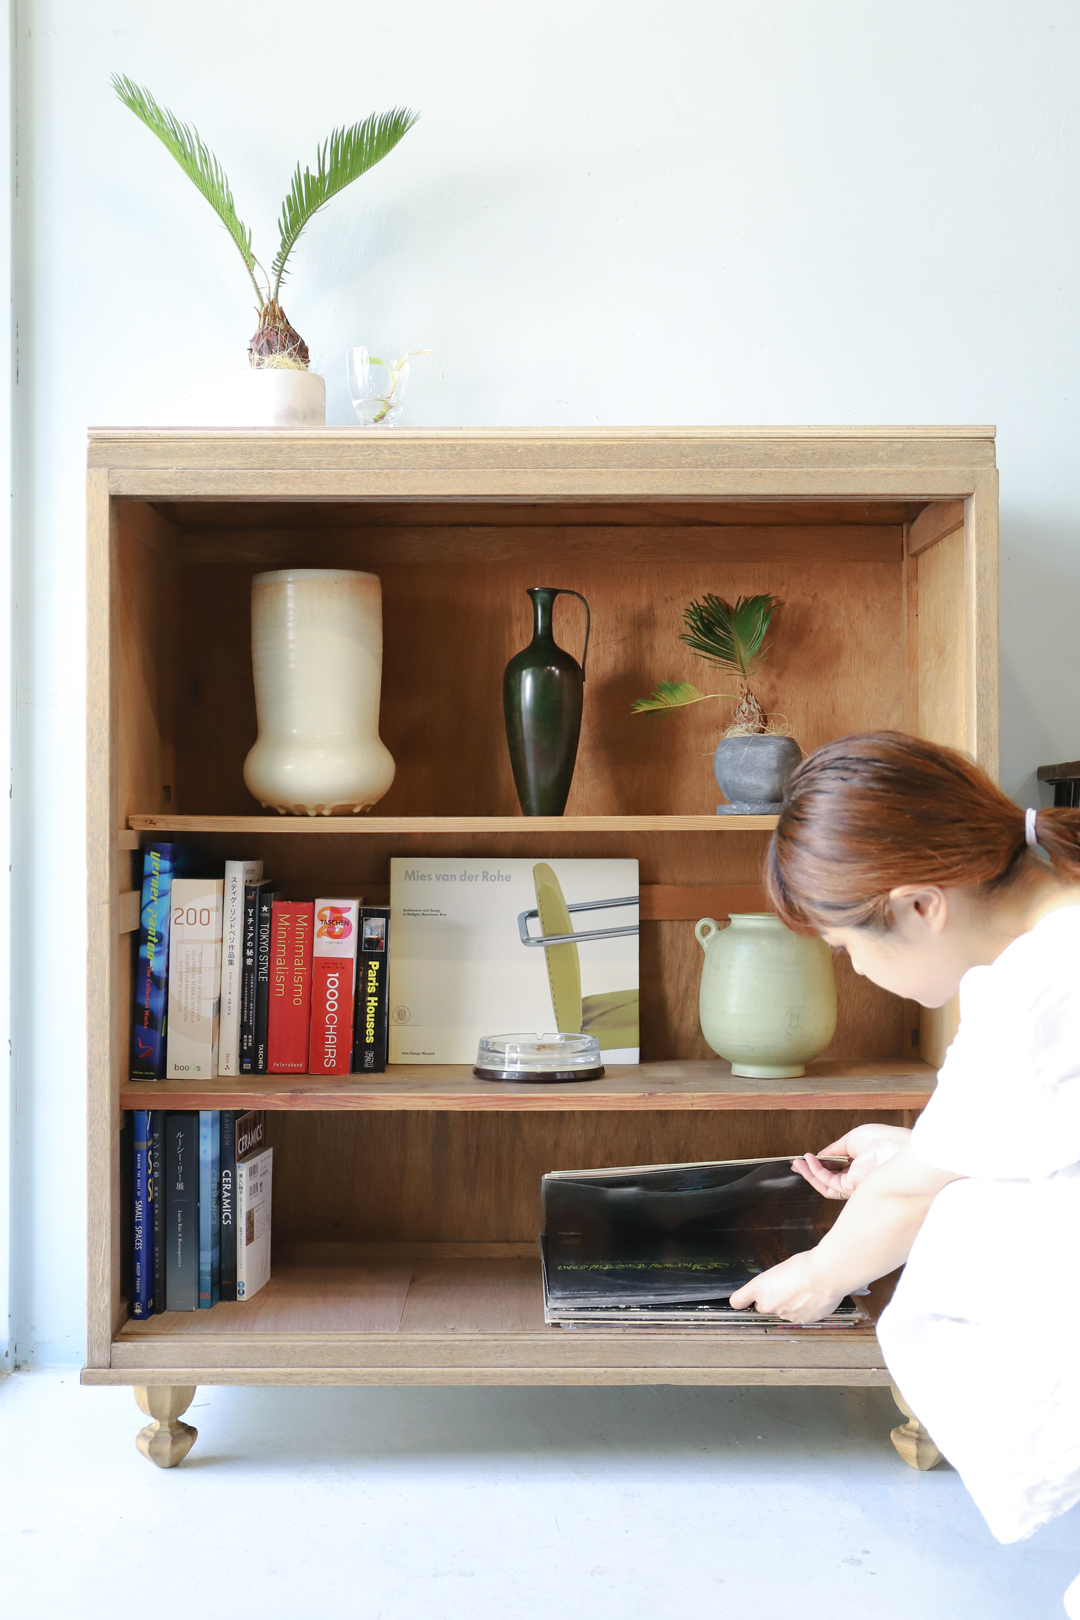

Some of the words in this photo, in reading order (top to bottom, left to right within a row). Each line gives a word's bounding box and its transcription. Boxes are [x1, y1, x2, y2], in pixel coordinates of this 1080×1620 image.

[403, 870, 433, 882] Mies
[434, 873, 457, 882] van
[459, 870, 480, 882] der
[481, 870, 512, 882] Rohe
[174, 907, 210, 926] 200
[246, 908, 255, 966] Yチェアの秘密
[259, 923, 270, 953] TOKYO
[258, 954, 269, 982] STYLE
[275, 914, 291, 997] Minimalism
[293, 914, 309, 1006] Minimalismo
[326, 972, 339, 1012] 1000
[367, 961, 380, 993] Paris
[365, 996, 378, 1044] Houses
[323, 1013, 338, 1068] CHAIRS
[237, 1123, 263, 1154] CERAMICS
[176, 1131, 184, 1191] ルーシー・リー展
[135, 1200, 143, 1222] SMALL
[222, 1169, 232, 1225] CERAMICS
[135, 1225, 143, 1250] SPACES
